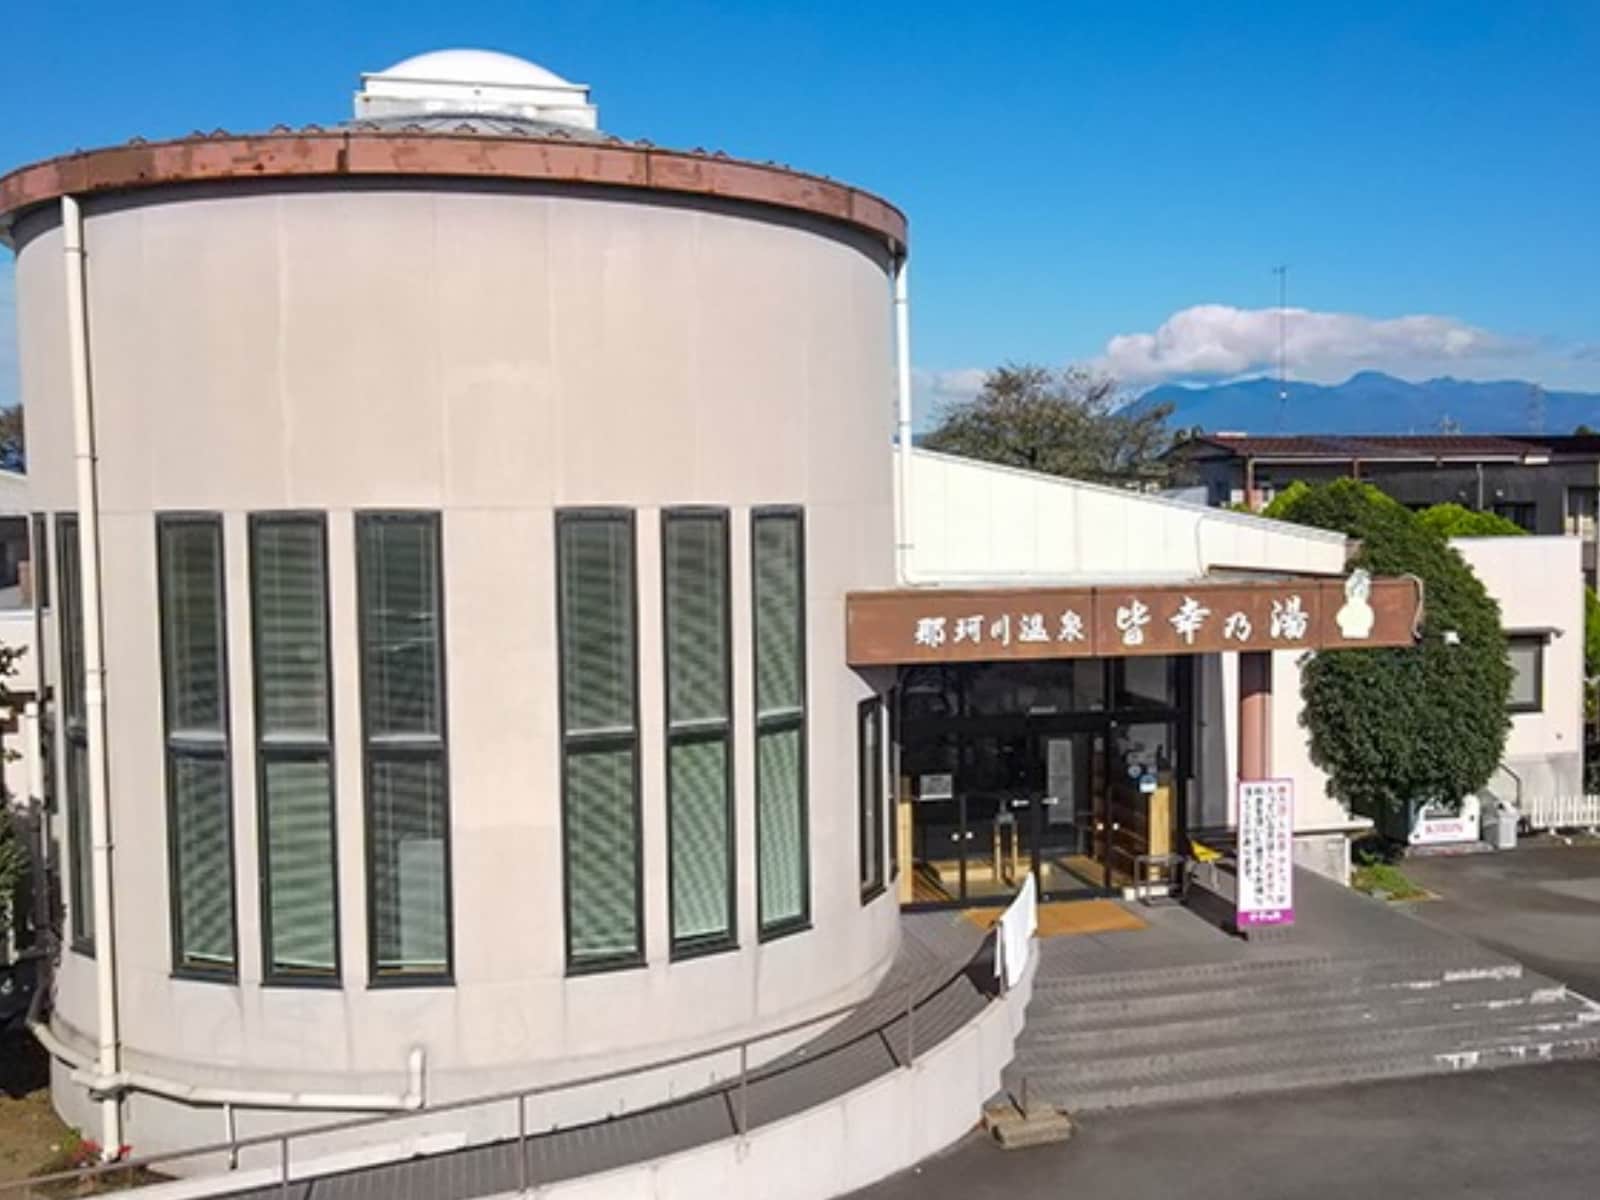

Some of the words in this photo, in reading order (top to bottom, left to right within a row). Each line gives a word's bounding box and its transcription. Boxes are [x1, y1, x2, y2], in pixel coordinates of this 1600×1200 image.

[914, 609, 1085, 648] 那珂川温泉
[1115, 595, 1309, 646] 皆幸乃湯
